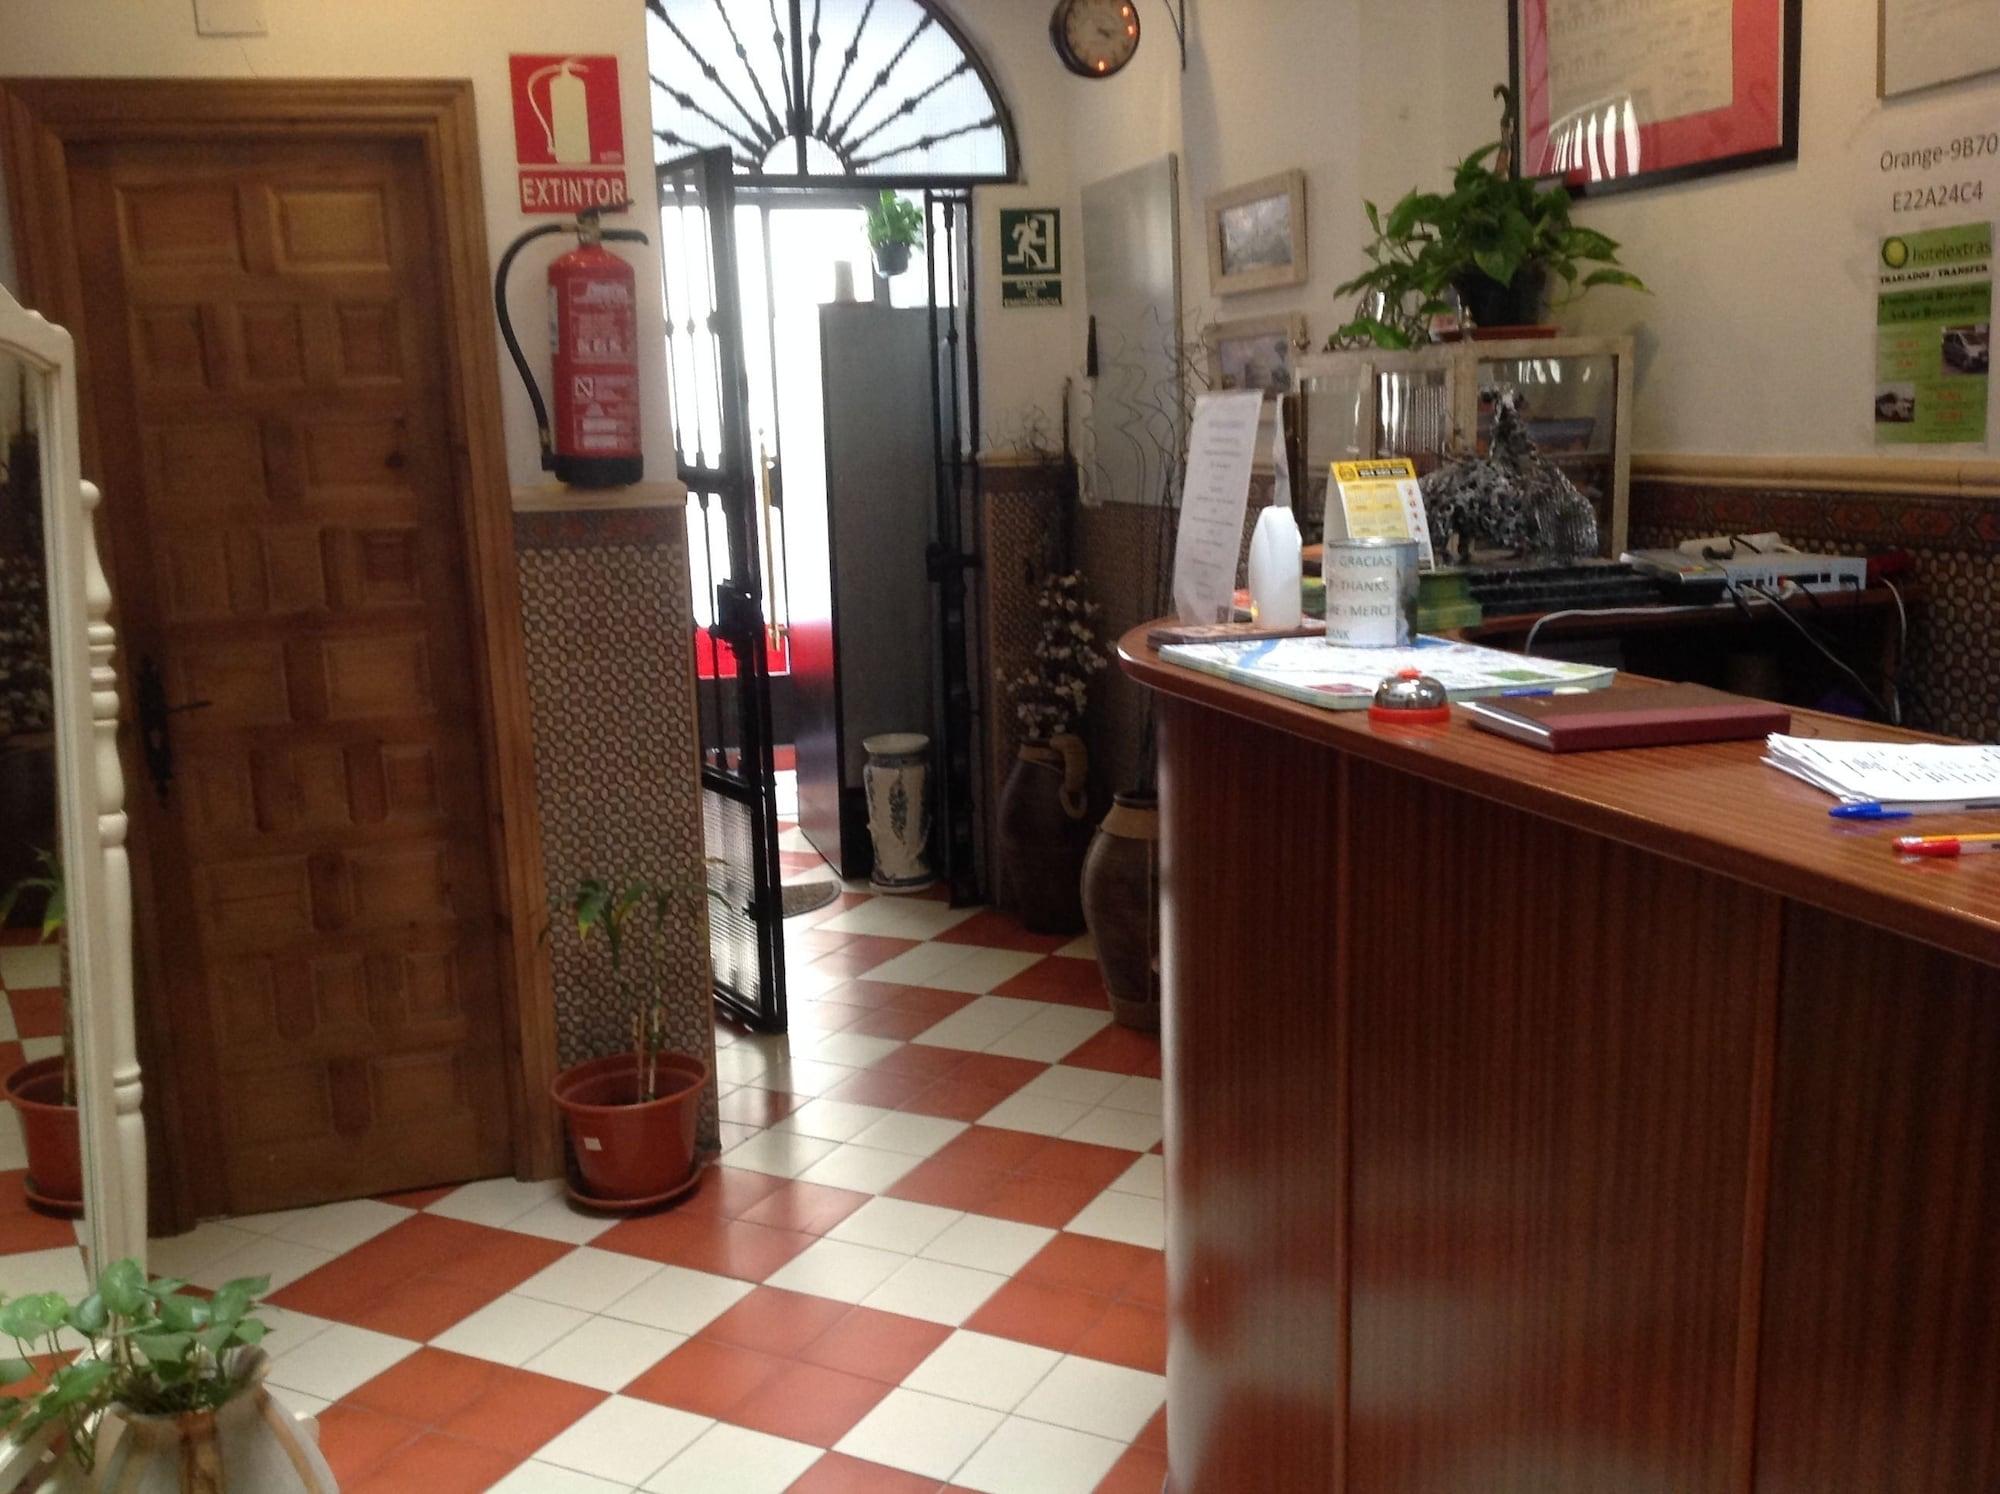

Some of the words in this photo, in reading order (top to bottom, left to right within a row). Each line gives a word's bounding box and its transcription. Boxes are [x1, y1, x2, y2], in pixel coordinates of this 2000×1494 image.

[1880, 132, 1998, 172] Orange-9B70
[521, 177, 626, 207] EXTINTOR
[1892, 180, 1983, 213] E22A24C4
[1938, 263, 1988, 278] TRANSFER
[1340, 555, 1393, 569] GRACIAS
[1341, 581, 1390, 593] THANKS
[1350, 605, 1392, 617] MERCI
